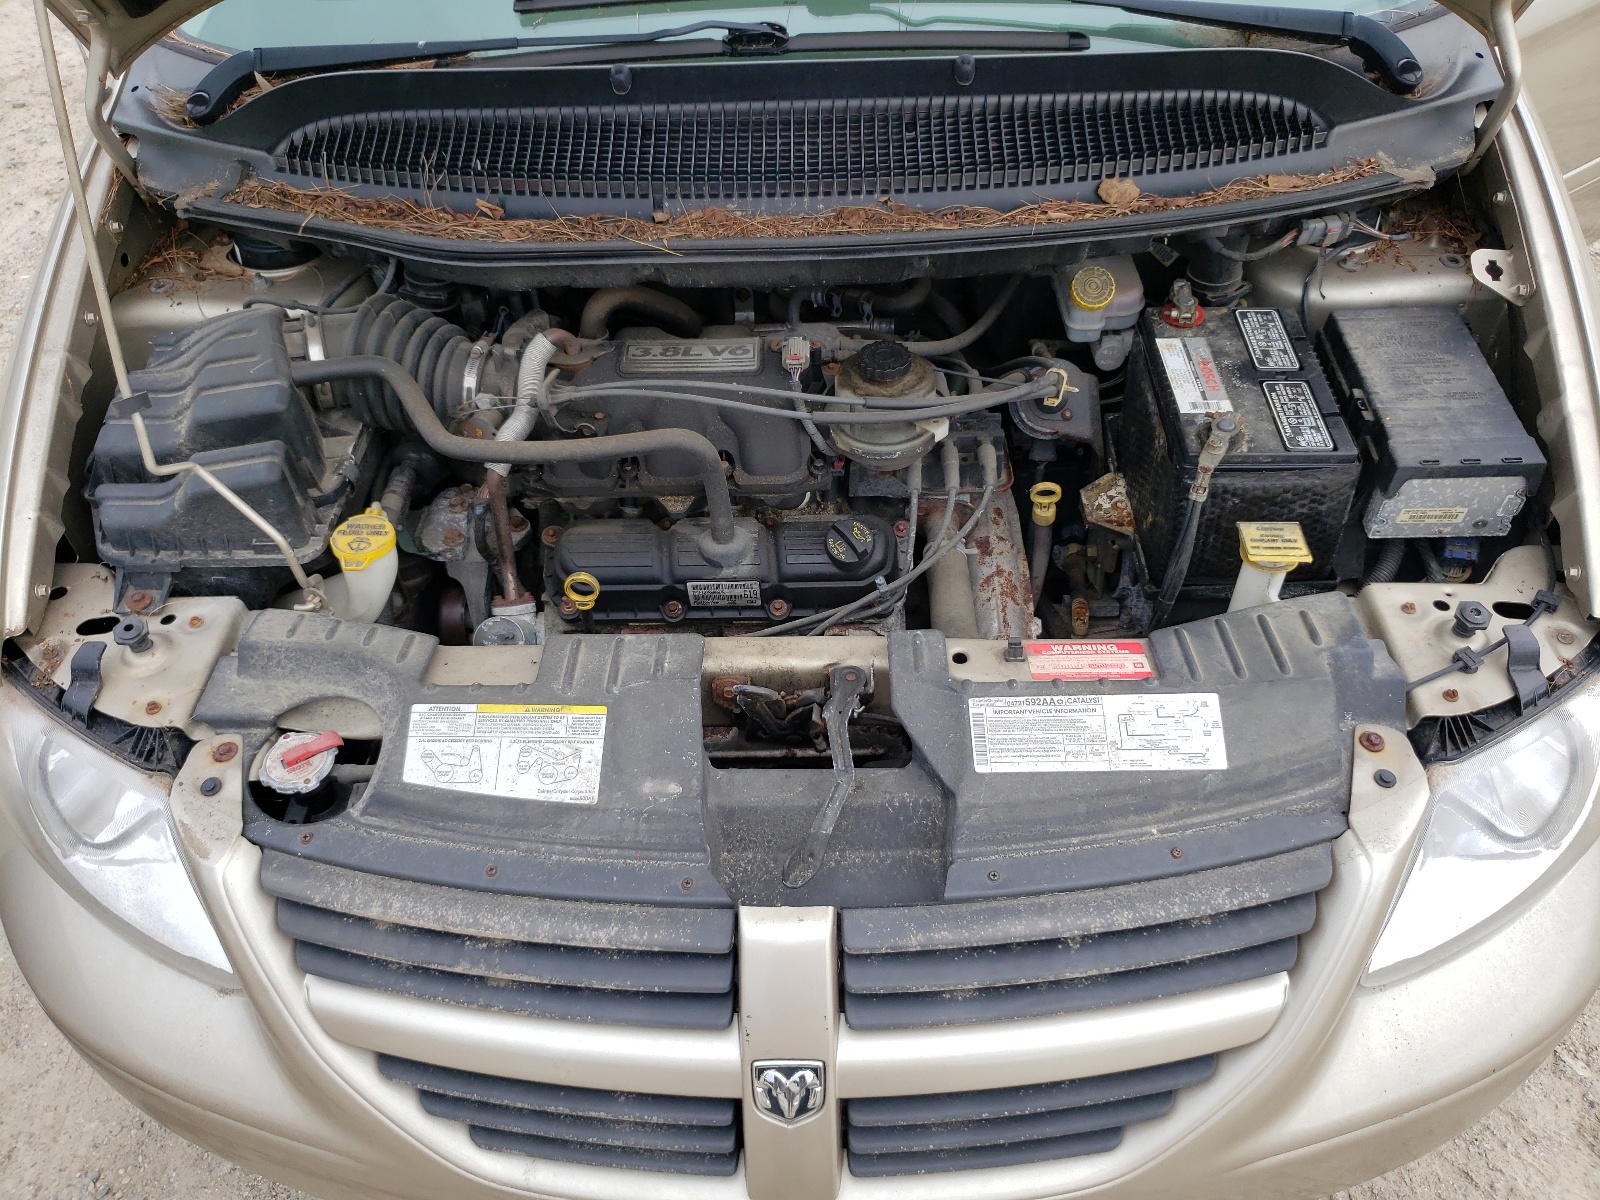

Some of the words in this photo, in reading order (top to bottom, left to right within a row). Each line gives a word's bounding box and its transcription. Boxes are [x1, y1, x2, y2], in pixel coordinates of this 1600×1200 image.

[631, 346, 703, 358] 3.8L
[707, 345, 751, 357] V6
[1198, 359, 1219, 393] BOSCH
[743, 589, 758, 599] 619
[1066, 696, 1100, 704] CATALYST
